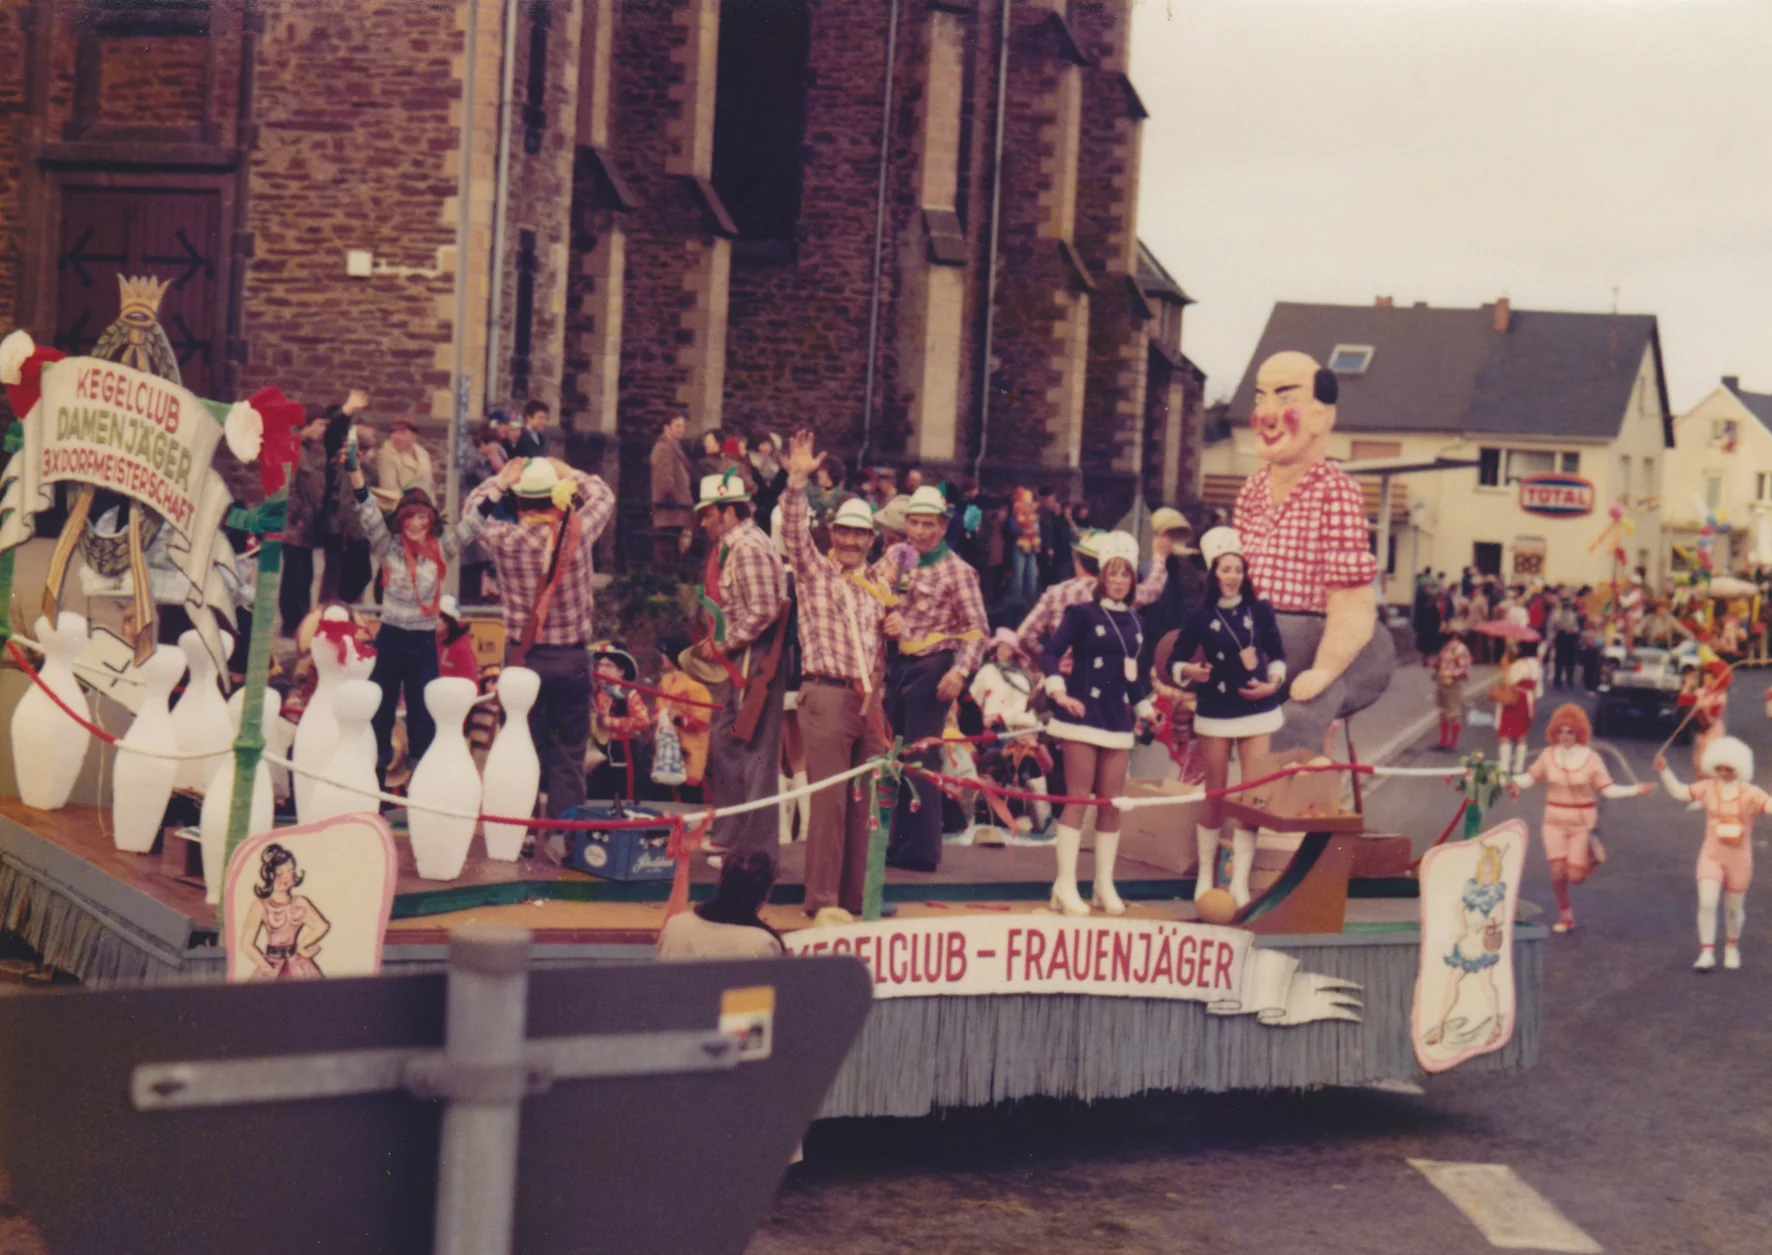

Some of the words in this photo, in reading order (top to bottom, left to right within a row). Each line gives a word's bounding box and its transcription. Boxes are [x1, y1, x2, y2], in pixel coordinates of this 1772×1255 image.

[77, 368, 181, 434] KEGELCLUB
[56, 406, 193, 493] DAMENJÄGER
[1528, 487, 1588, 506] TOTAL
[787, 931, 968, 984] ELCLUB
[1006, 925, 1234, 990] FRAUENJÄGER
